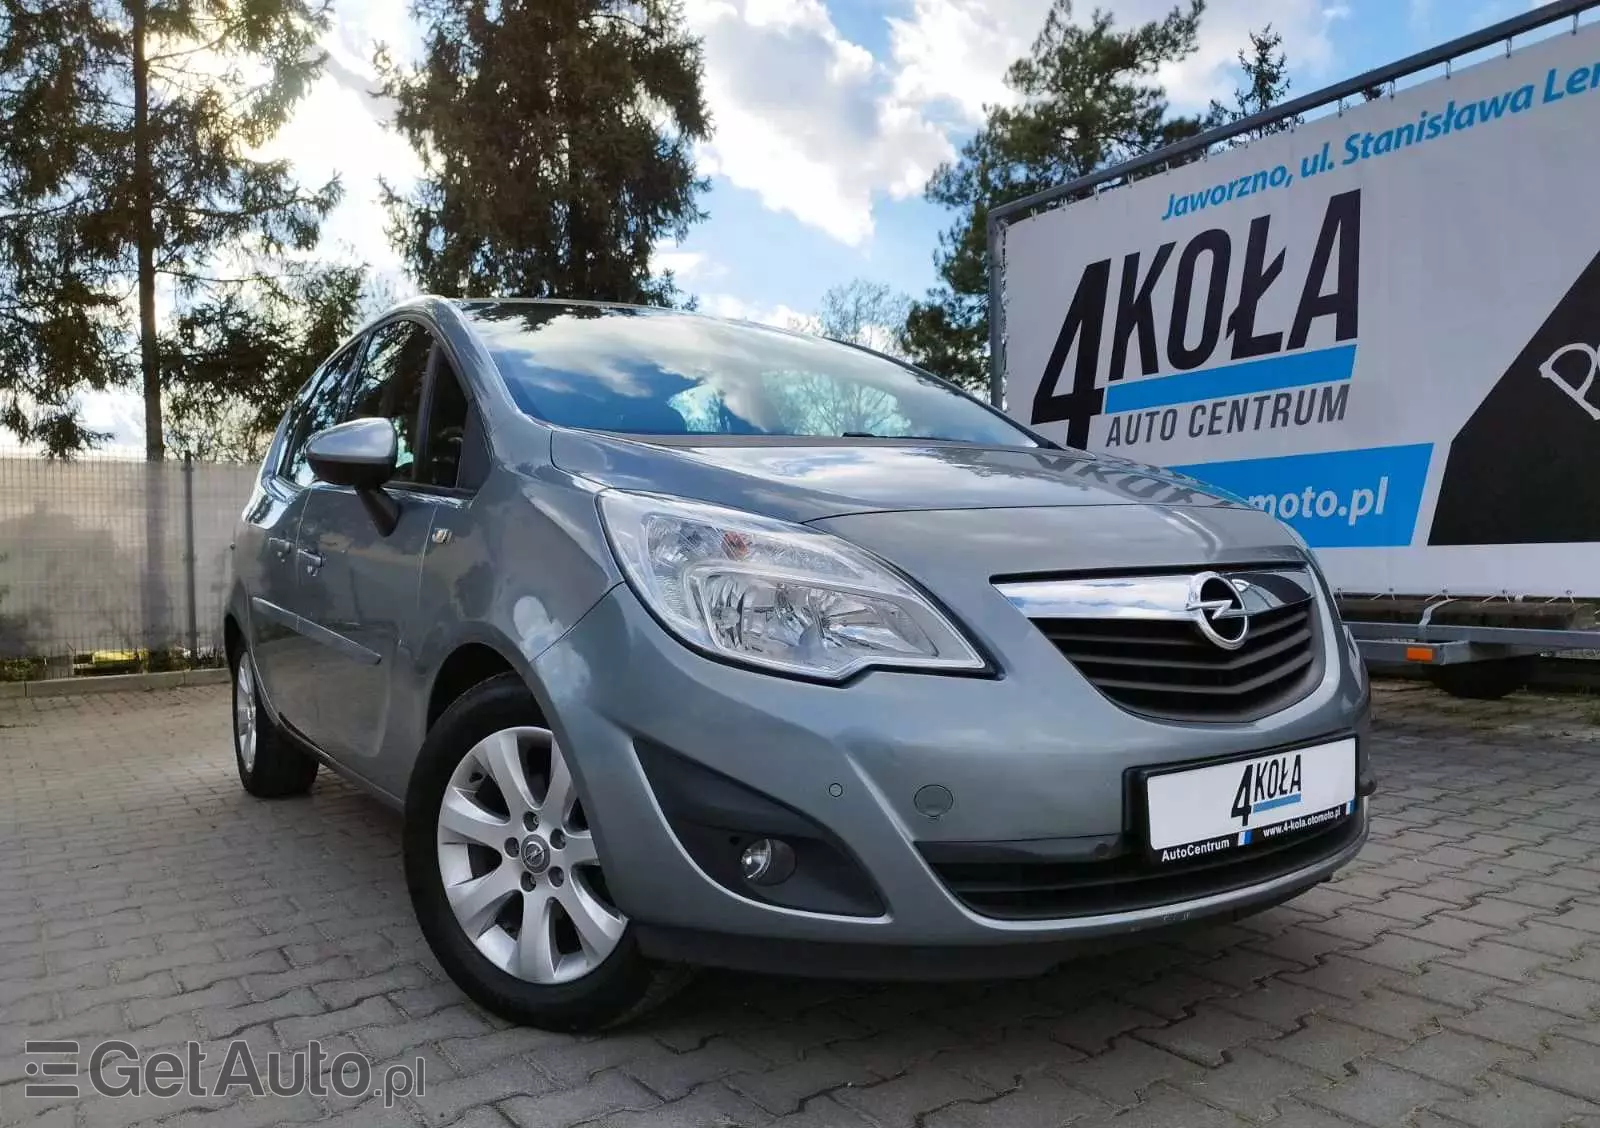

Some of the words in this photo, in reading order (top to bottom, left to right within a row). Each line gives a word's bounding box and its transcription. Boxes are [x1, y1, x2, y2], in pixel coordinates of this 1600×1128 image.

[1161, 163, 1292, 222] Jaworzno,
[1300, 147, 1335, 178] ul.
[1343, 84, 1535, 166] Stanisława
[1105, 408, 1178, 447] AUTO
[1188, 384, 1351, 437] CENTRUM
[1263, 807, 1341, 838] www.4-kola.otomoto.pl
[1161, 838, 1230, 863] AutoCentrum
